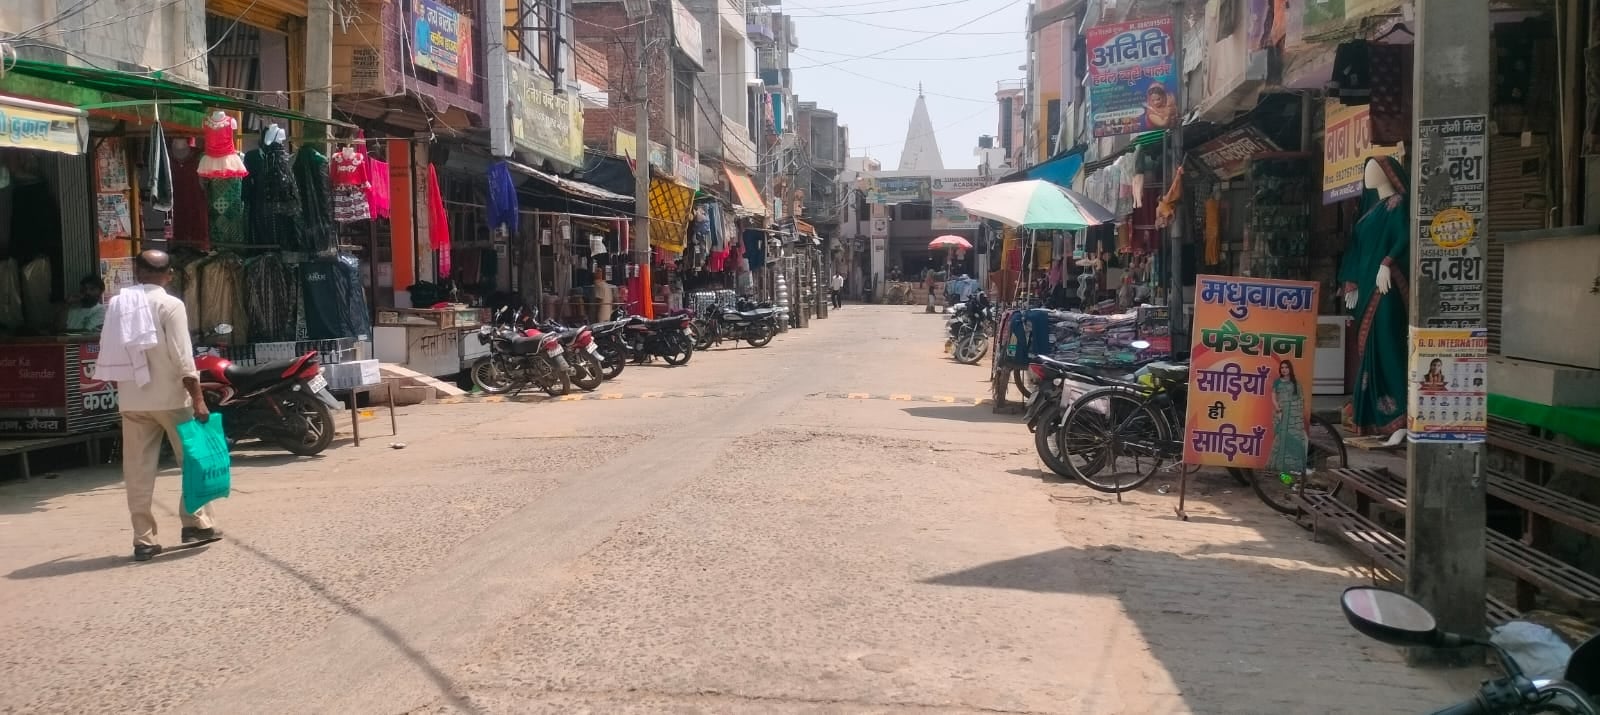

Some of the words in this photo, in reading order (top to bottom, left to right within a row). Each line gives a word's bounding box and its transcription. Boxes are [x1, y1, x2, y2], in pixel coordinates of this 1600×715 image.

[1090, 28, 1170, 67] अदिति
[11, 116, 49, 142] दुकान
[1326, 118, 1350, 164] बाबा
[1419, 125, 1439, 137] गुप्त
[1441, 120, 1460, 133] रोगी
[1463, 118, 1484, 132] मिलें
[1201, 280, 1314, 319] मधुवाला
[1201, 320, 1307, 358] फैशन
[1197, 363, 1270, 400] साड़ियाँ
[1208, 401, 1225, 419] ही
[1192, 424, 1265, 462] साड़ियाँ
